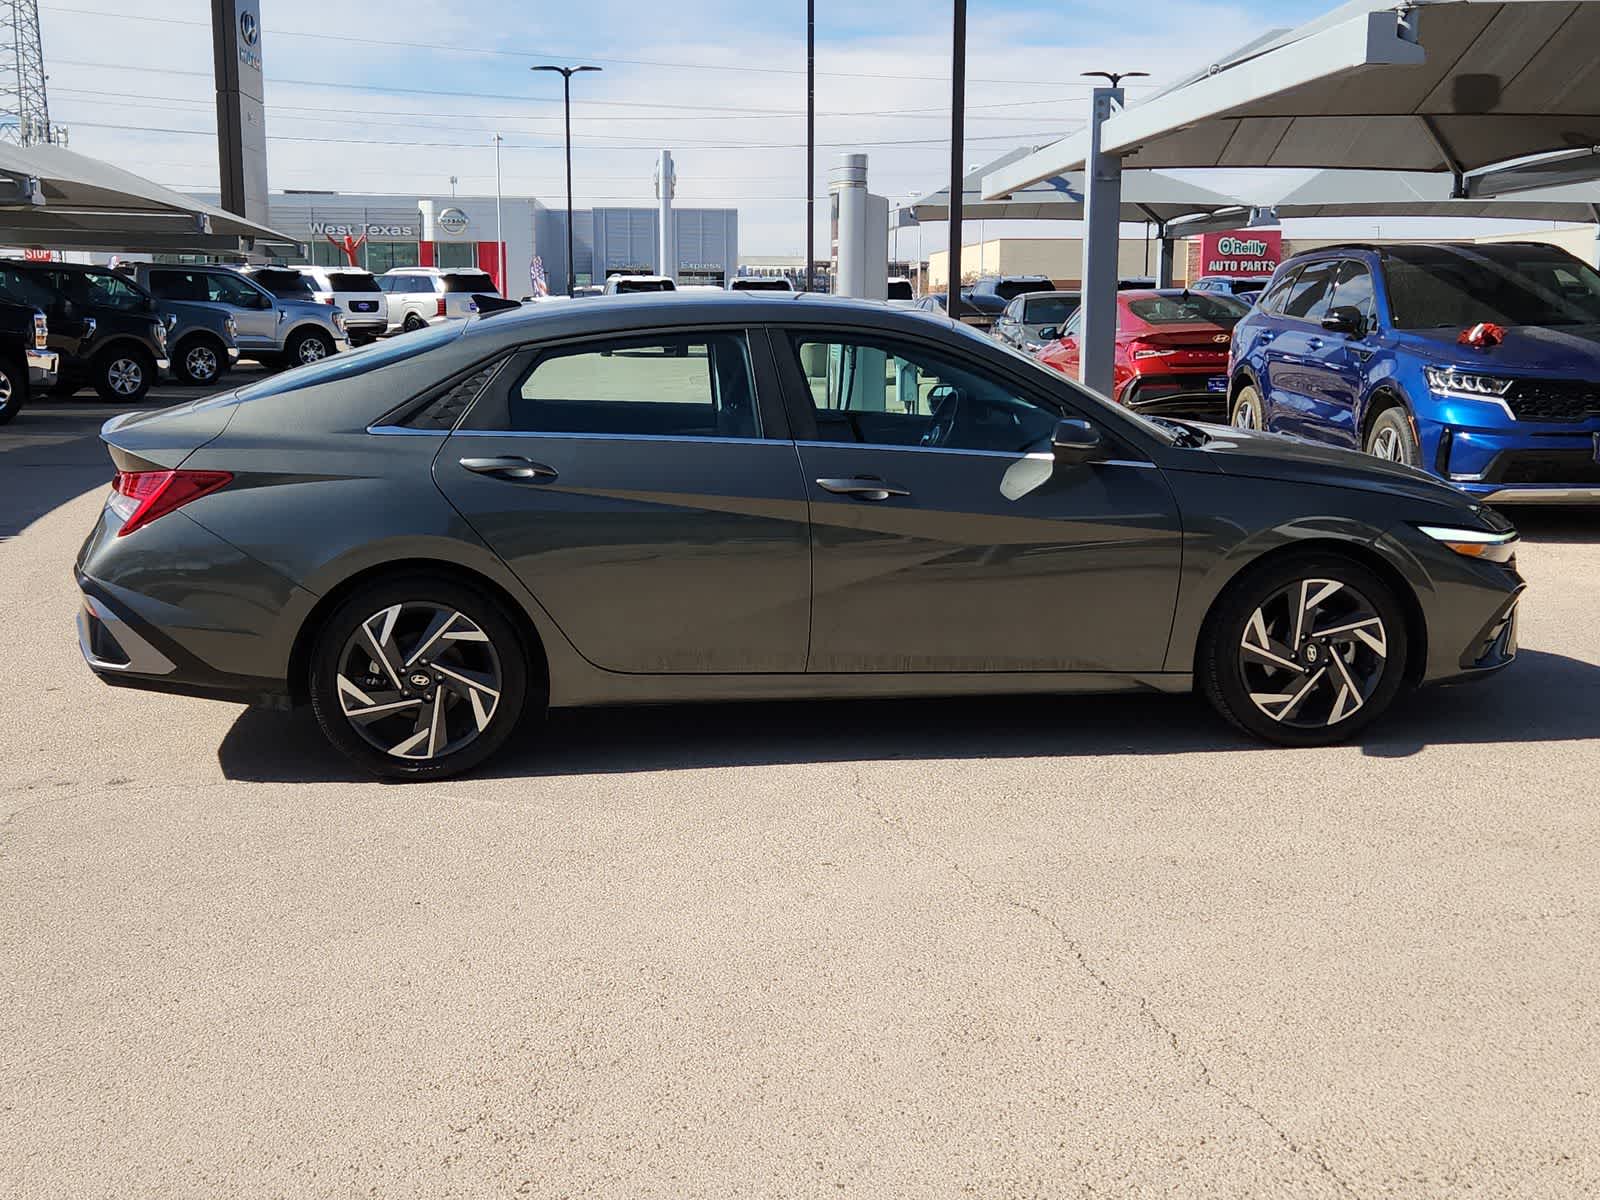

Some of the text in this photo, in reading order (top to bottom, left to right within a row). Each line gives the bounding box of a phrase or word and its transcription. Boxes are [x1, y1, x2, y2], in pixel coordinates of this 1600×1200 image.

[308, 222, 413, 236] West Texas
[25, 248, 50, 259] STOP
[1218, 237, 1267, 257] O'Reilly
[1208, 260, 1276, 272] AUTO PARTS
